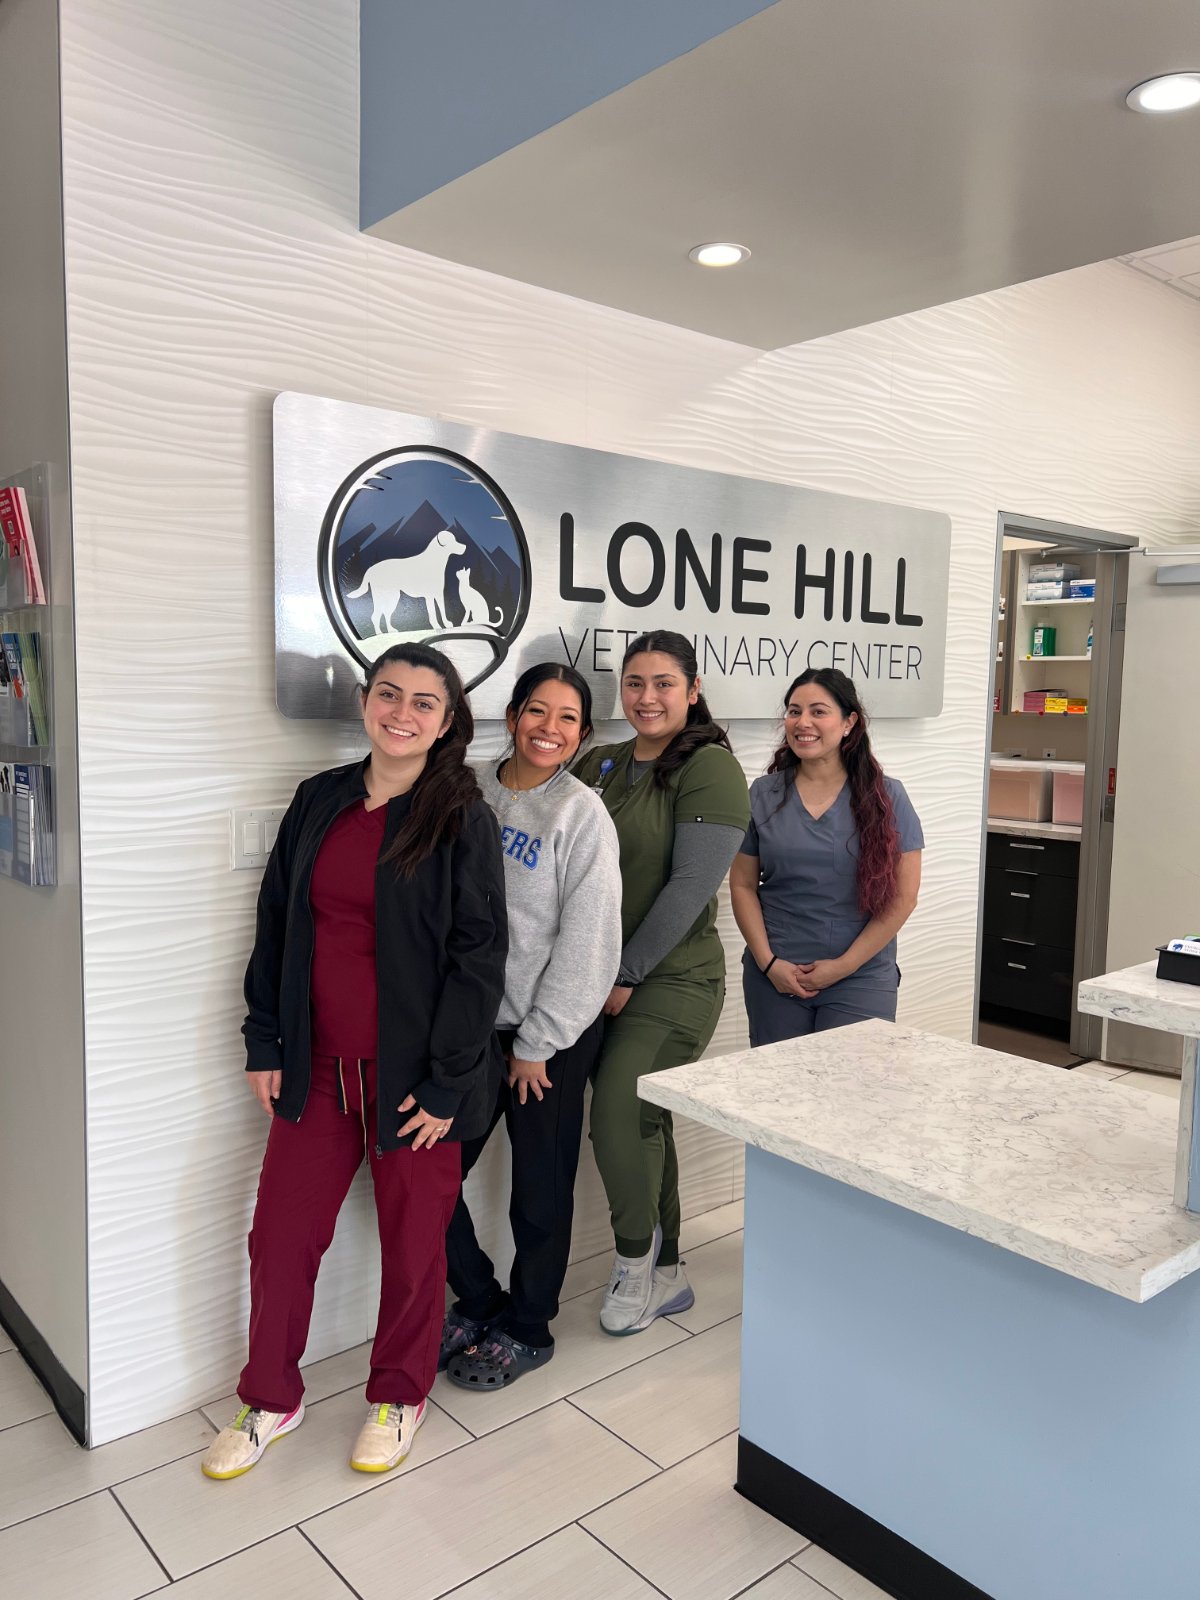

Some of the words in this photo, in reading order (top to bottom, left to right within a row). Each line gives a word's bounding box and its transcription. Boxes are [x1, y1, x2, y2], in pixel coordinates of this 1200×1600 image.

[559, 512, 772, 616] LONE
[794, 543, 924, 627] HILL
[558, 626, 799, 677] VETNARY
[806, 640, 923, 680] CENTER
